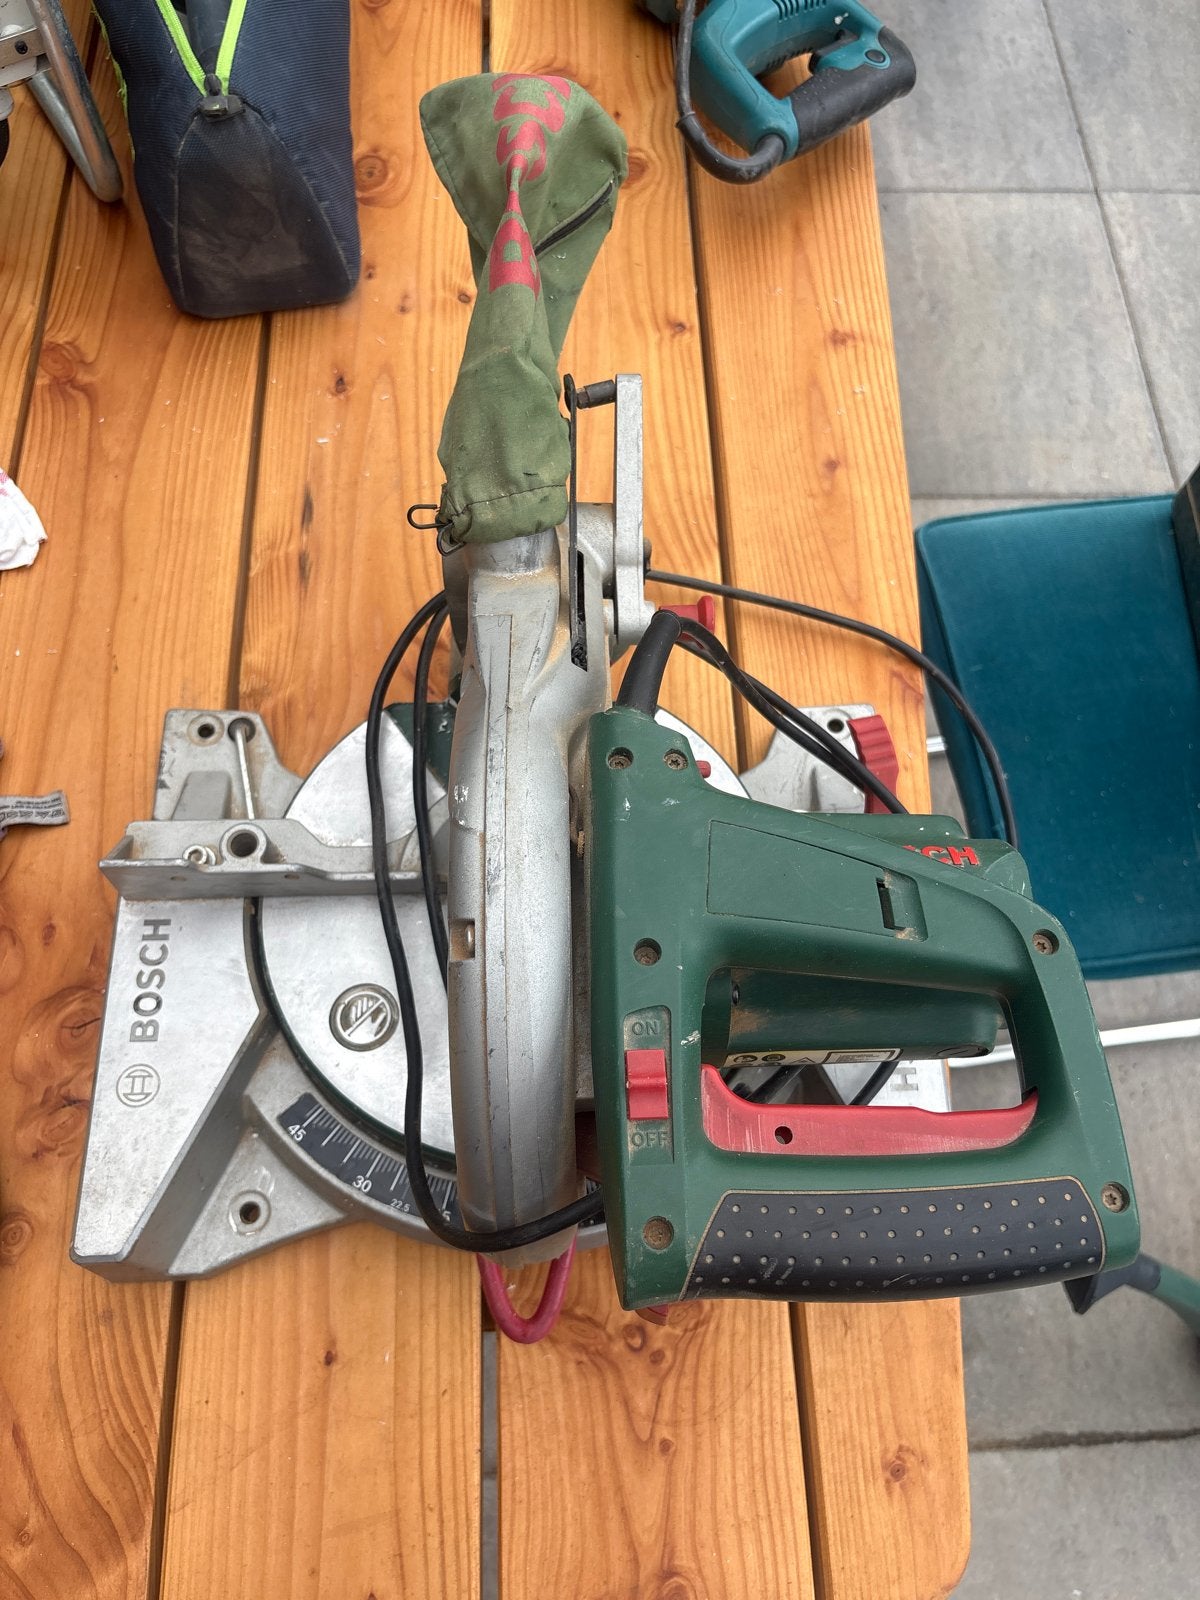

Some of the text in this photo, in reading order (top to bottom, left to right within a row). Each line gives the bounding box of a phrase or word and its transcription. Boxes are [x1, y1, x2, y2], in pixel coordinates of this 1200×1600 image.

[902, 844, 980, 867] CH
[129, 918, 172, 1043] BOSCH
[631, 1020, 659, 1036] ON
[287, 1124, 307, 1142] 45
[631, 1130, 669, 1148] OFF
[351, 1175, 373, 1194] 30
[389, 1197, 411, 1213] 22.5
[438, 1208, 452, 1223] 5
